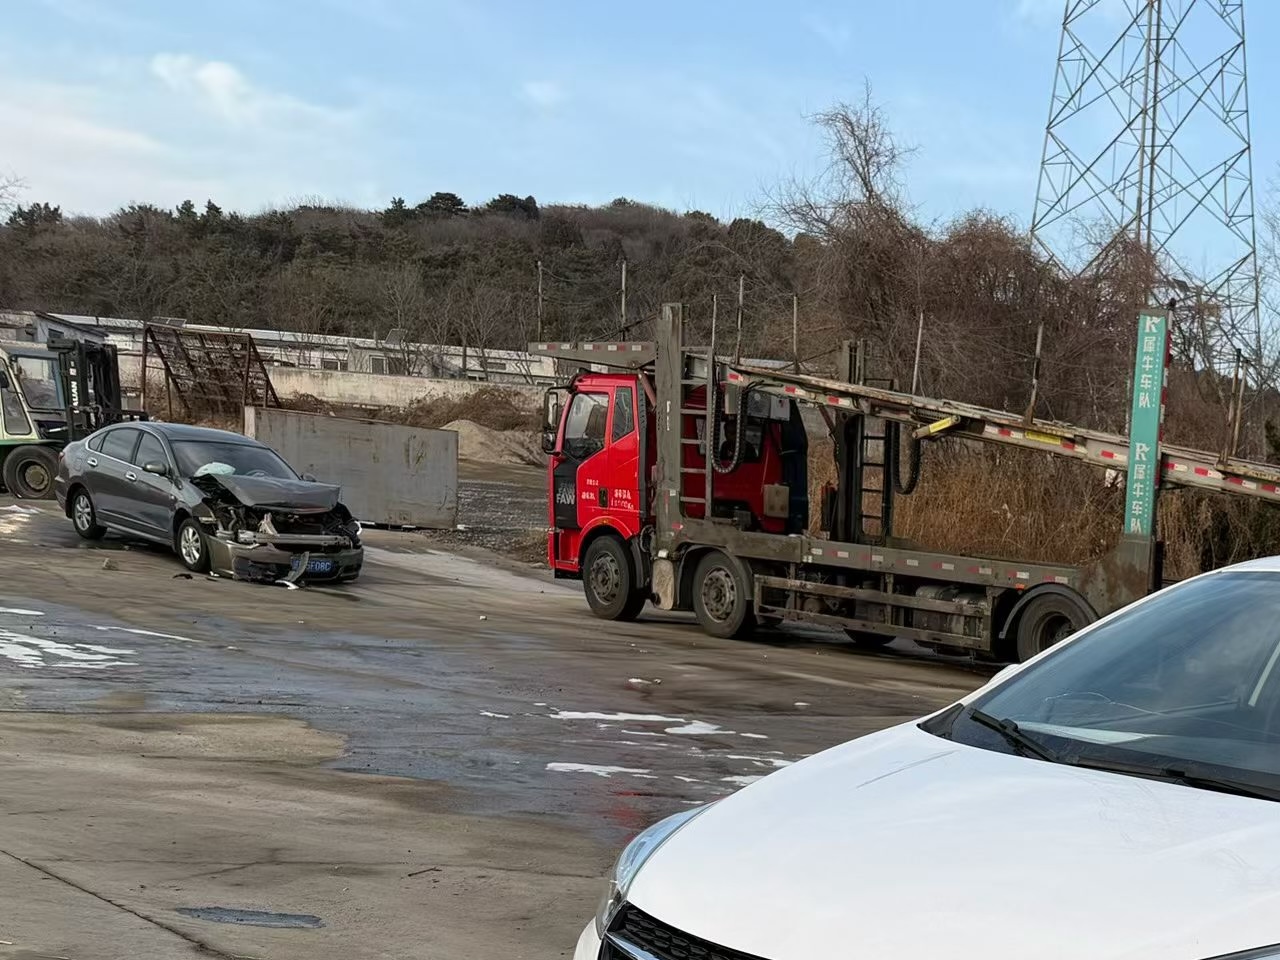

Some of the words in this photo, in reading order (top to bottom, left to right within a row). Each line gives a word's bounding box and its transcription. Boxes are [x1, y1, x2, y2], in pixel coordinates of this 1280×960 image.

[1139, 336, 1156, 408] 犀牛车队
[556, 493, 576, 505] FAW
[1130, 463, 1146, 534] 犀牛车队
